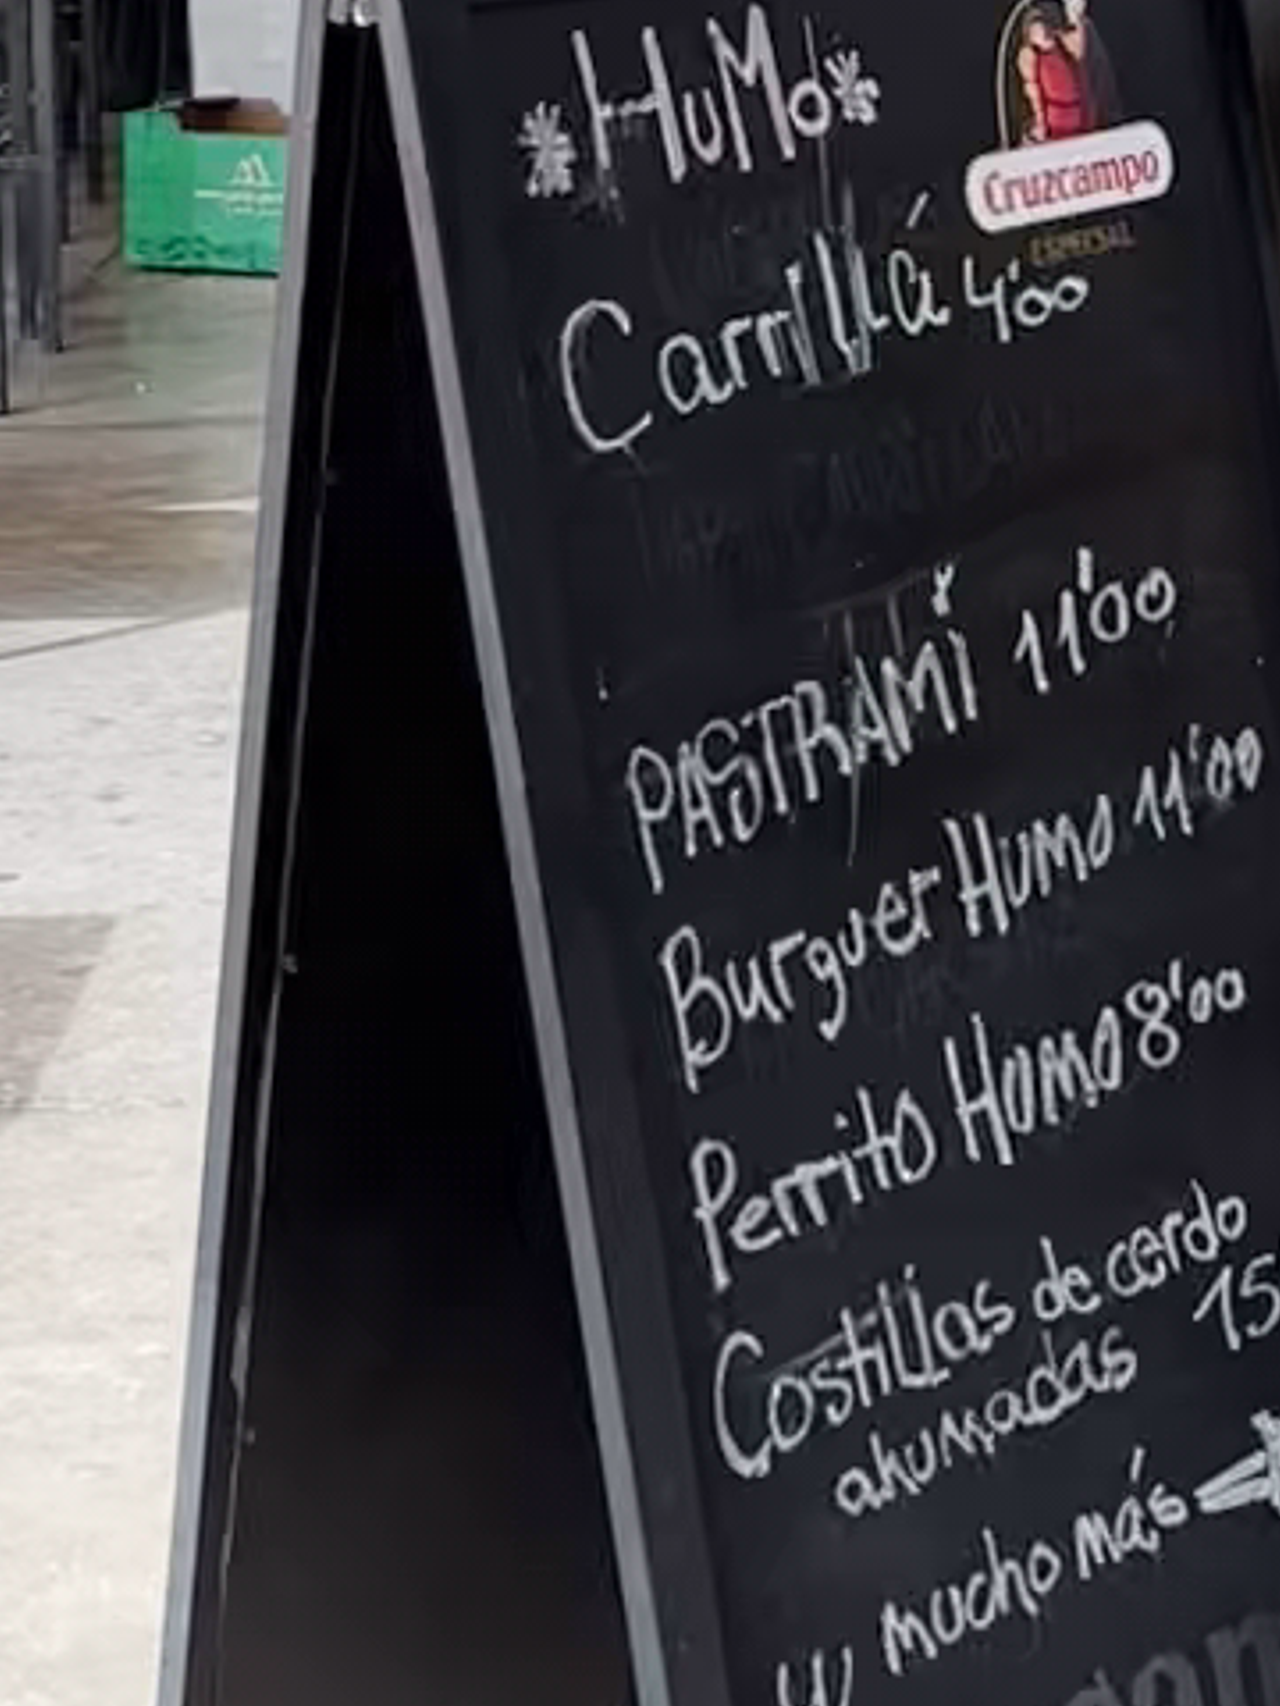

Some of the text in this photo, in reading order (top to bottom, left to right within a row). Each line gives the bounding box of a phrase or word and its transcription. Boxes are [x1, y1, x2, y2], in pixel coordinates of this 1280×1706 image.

[982, 149, 1160, 216] Cruzcampo
[662, 867, 940, 1092] Burguer
[690, 1087, 936, 1292] Perrito
[714, 1180, 1247, 1477] Costillas de cerdo
[834, 1327, 1136, 1517] ahumadas
[879, 1529, 1058, 1675] mucho
[1074, 1447, 1188, 1580] más
